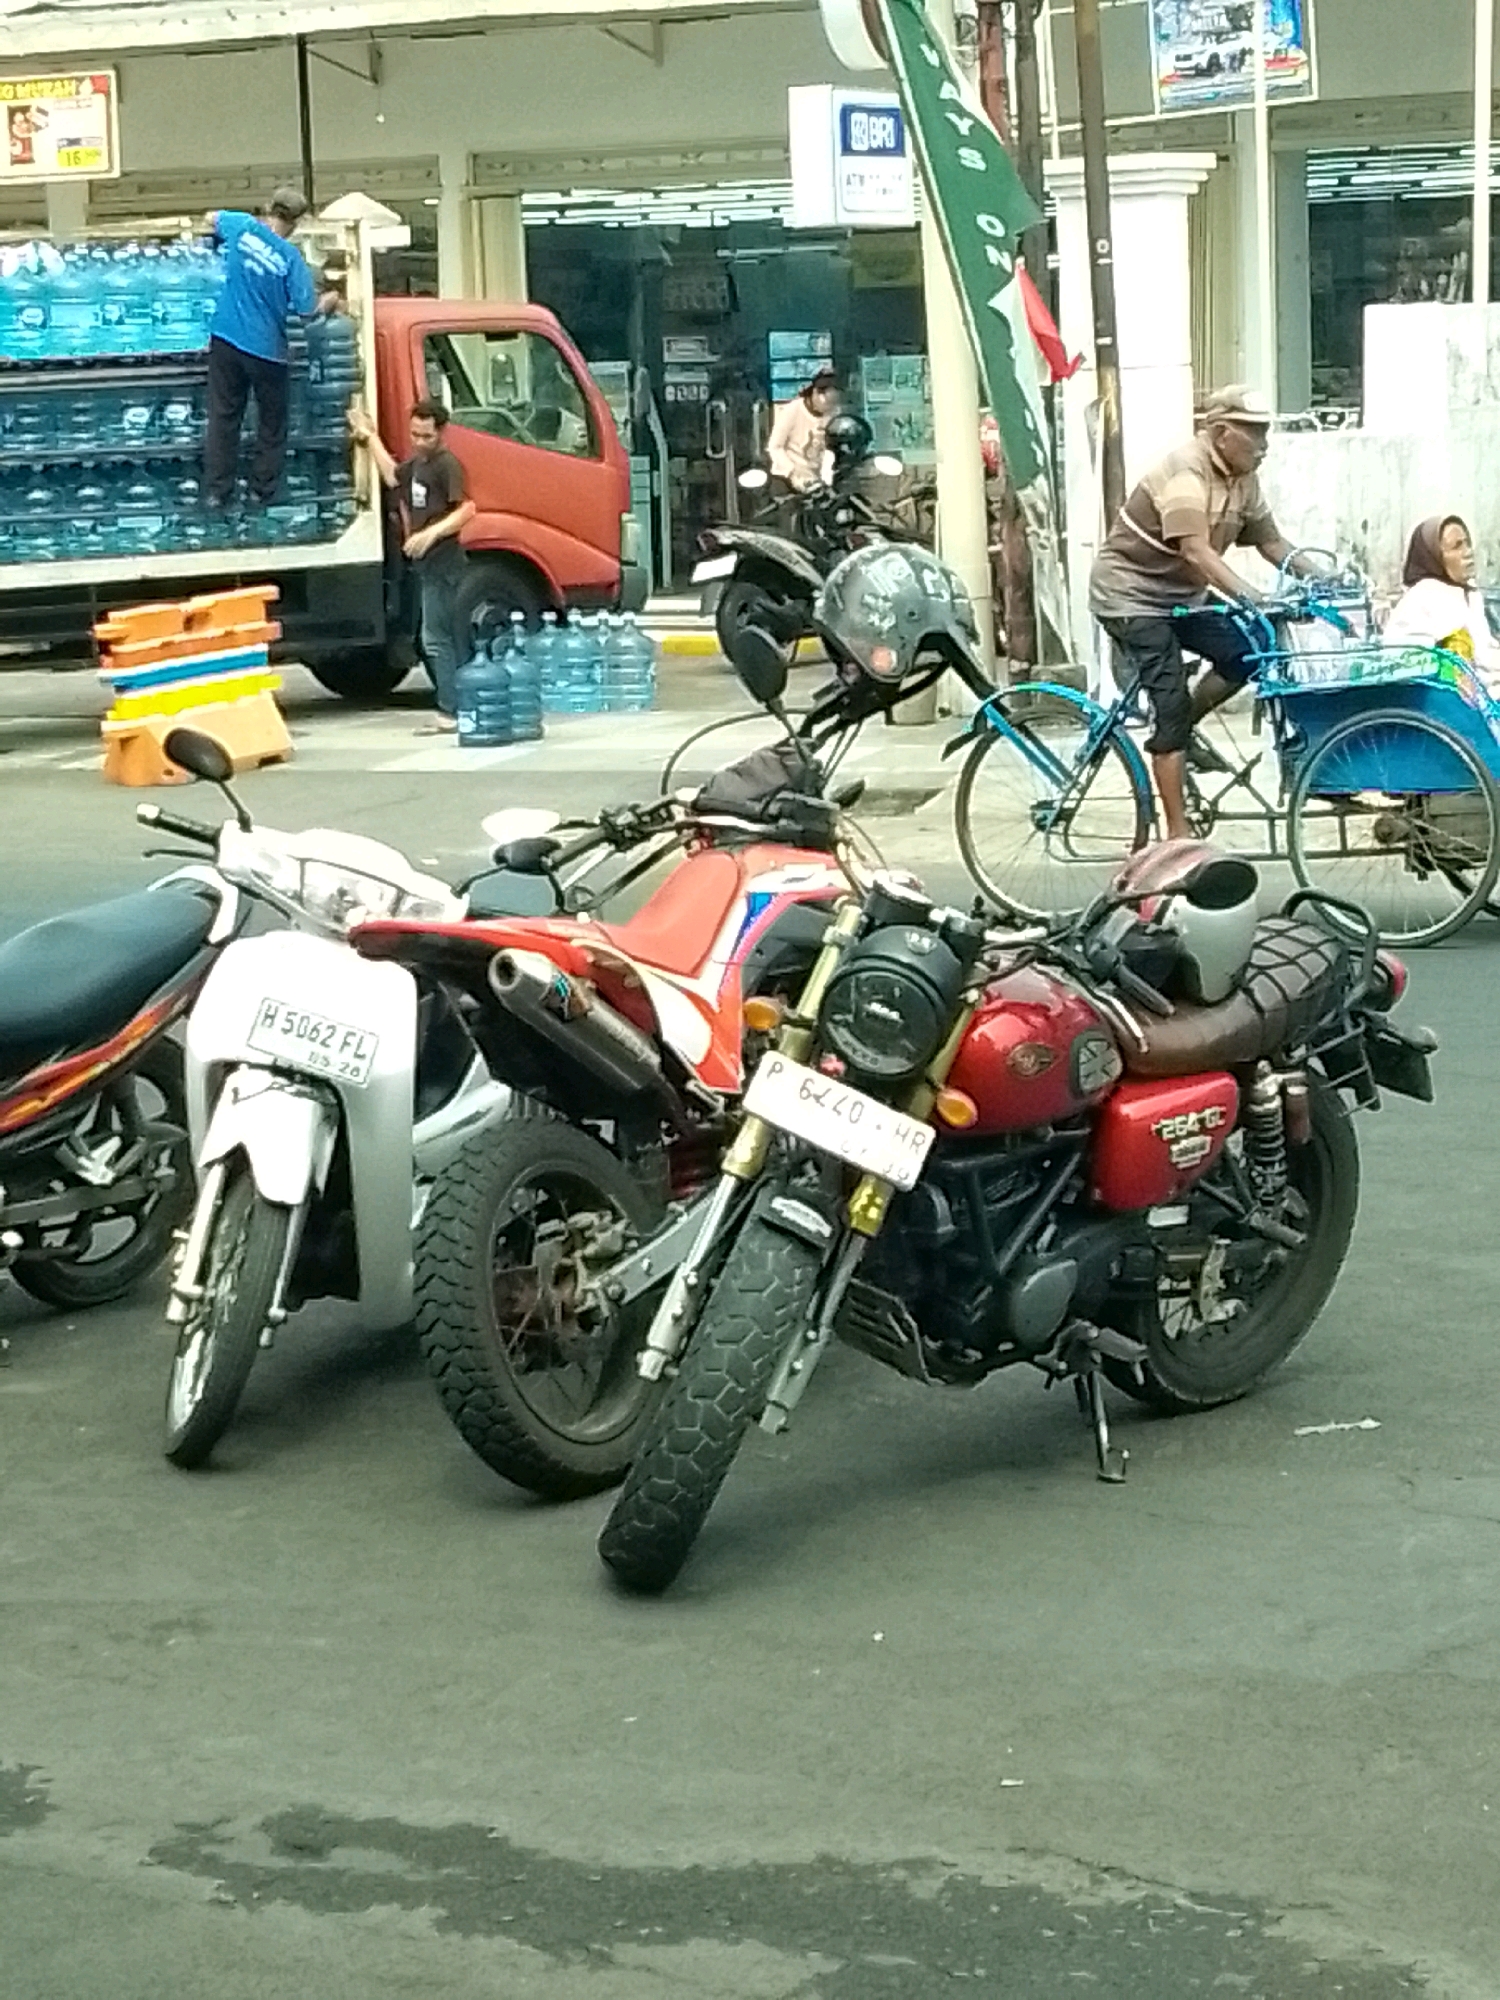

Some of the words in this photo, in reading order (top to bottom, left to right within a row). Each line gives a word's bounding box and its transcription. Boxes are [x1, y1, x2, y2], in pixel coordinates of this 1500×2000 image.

[868, 116, 896, 149] BRI
[261, 1003, 279, 1028] H
[281, 1010, 338, 1048] 5062
[339, 1030, 367, 1061] FL
[767, 1060, 784, 1079] P
